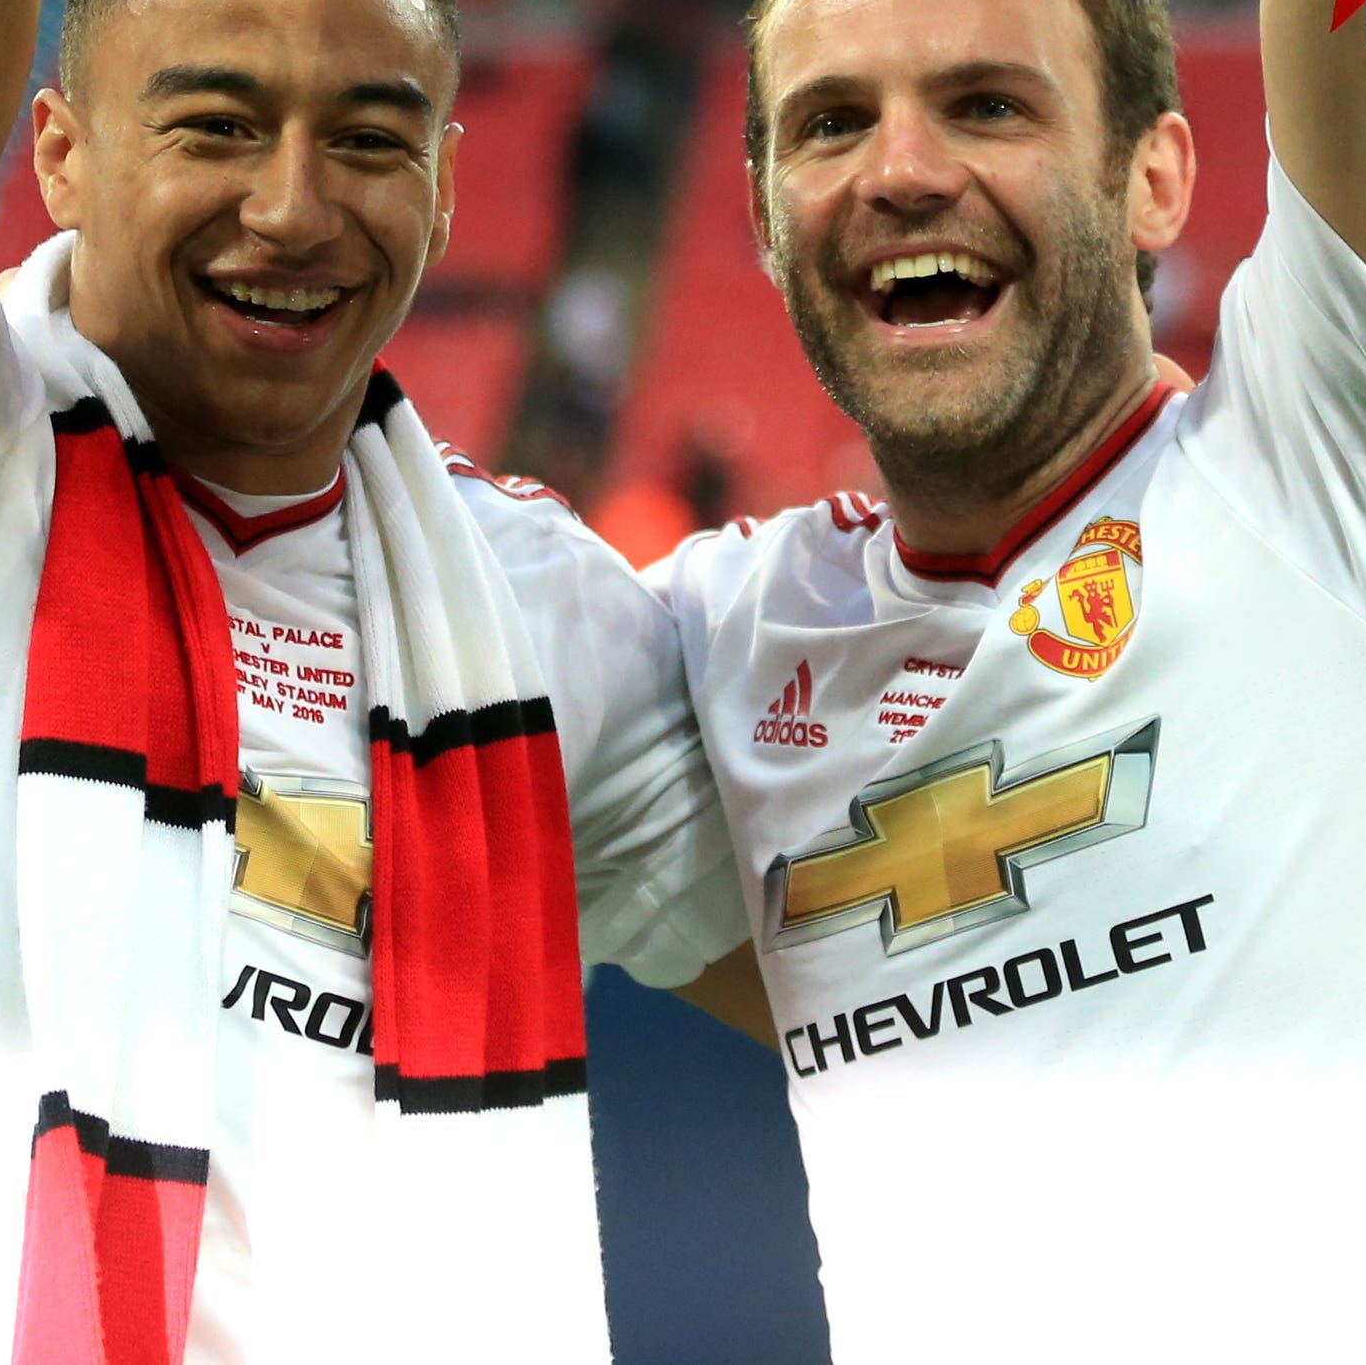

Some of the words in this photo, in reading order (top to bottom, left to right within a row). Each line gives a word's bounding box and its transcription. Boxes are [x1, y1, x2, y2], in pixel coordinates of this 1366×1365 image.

[272, 627, 344, 649] PALACE
[296, 665, 355, 688] UNITED
[251, 691, 285, 714] MAY
[292, 704, 325, 724] 2016
[276, 682, 348, 710] STADIUM
[753, 714, 829, 748] adidas
[784, 894, 1215, 1078] CHEVROLET
